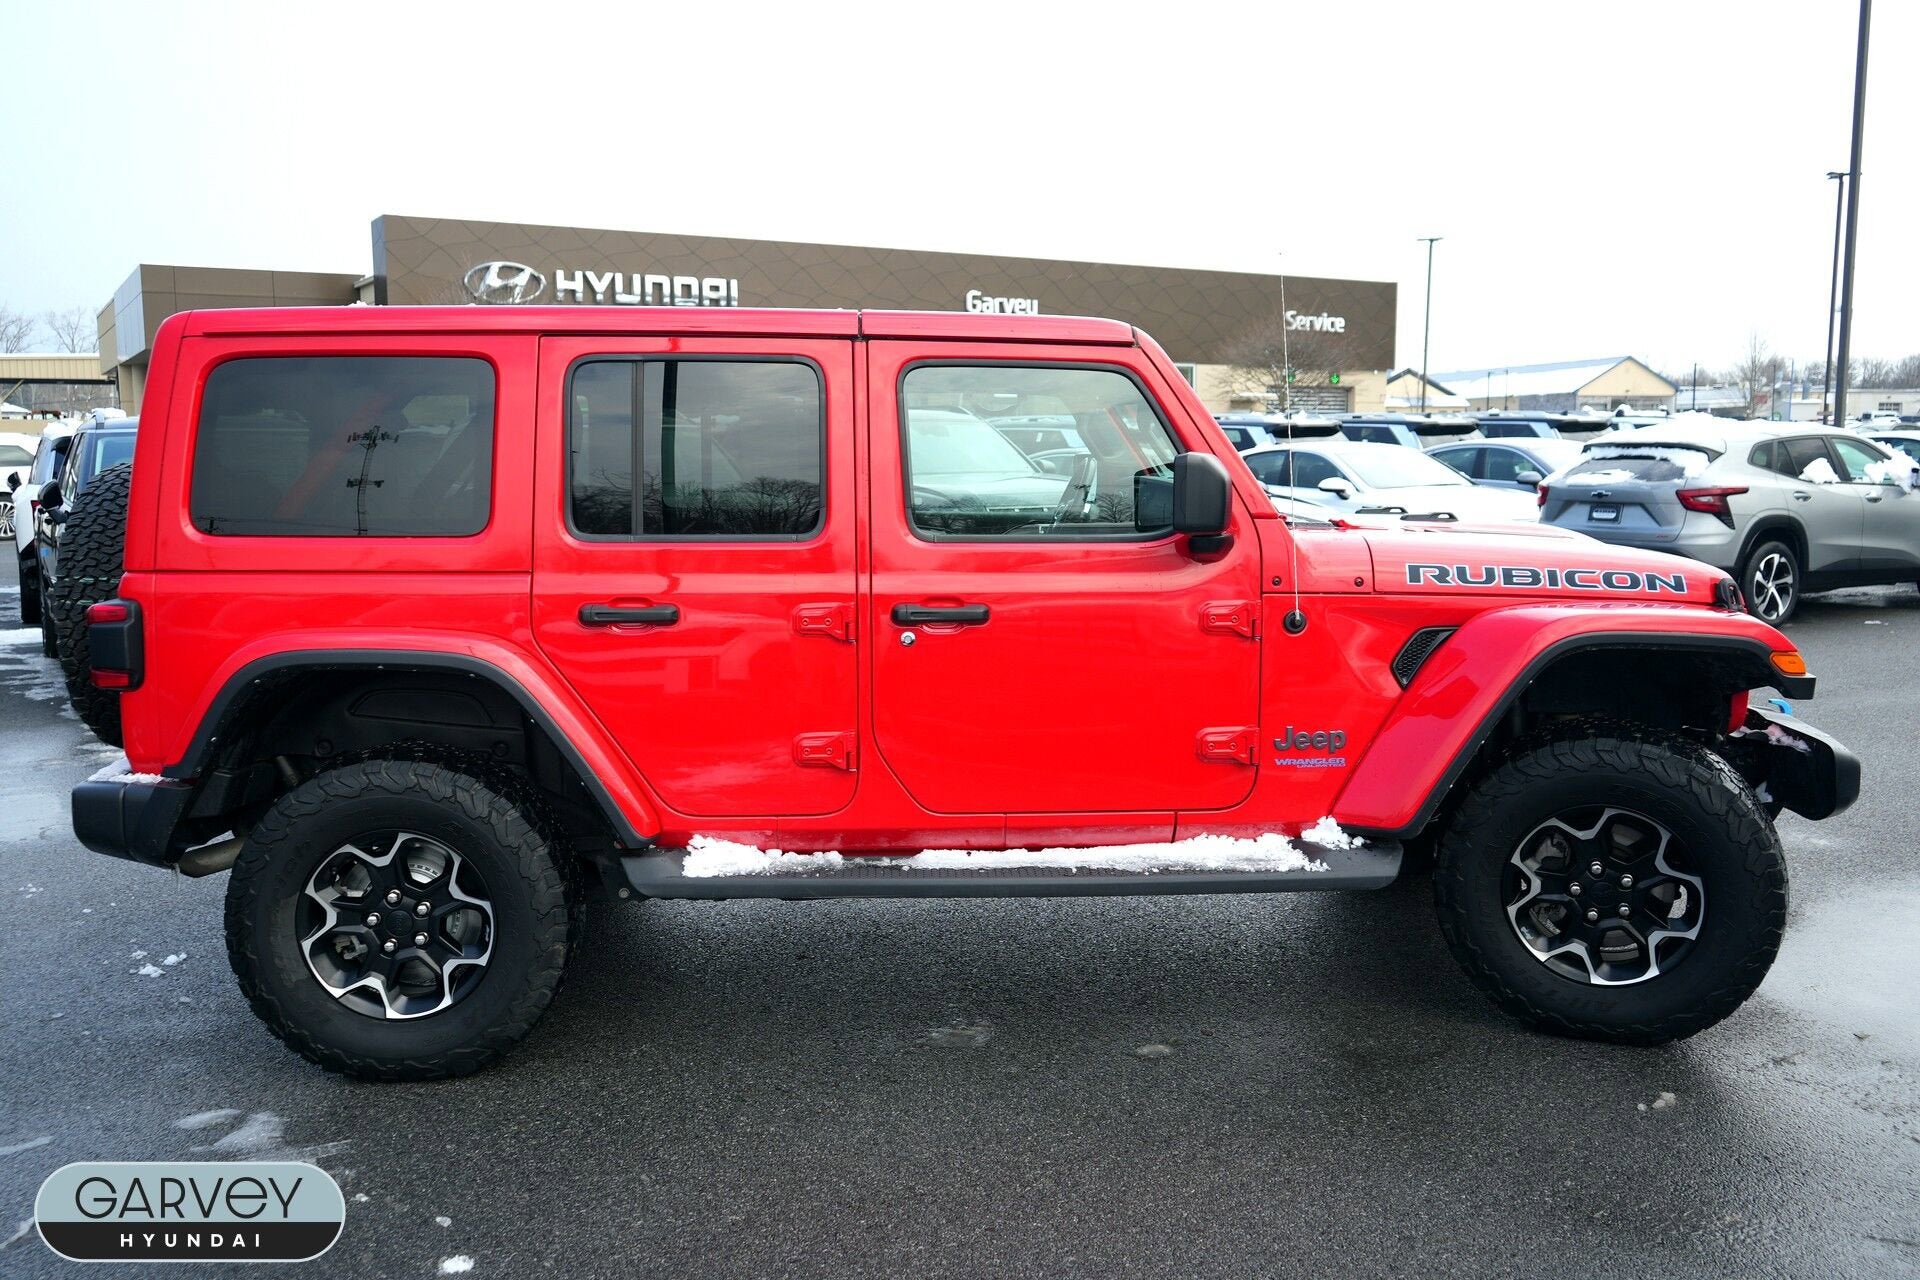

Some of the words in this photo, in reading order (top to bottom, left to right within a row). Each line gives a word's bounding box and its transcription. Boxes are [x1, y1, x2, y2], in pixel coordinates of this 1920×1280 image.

[556, 269, 738, 307] HYUNDAI
[1285, 310, 1345, 333] Service
[1406, 562, 1688, 594] RUBICON
[1274, 725, 1346, 754] Jeep
[1274, 757, 1346, 765] WRANGLER
